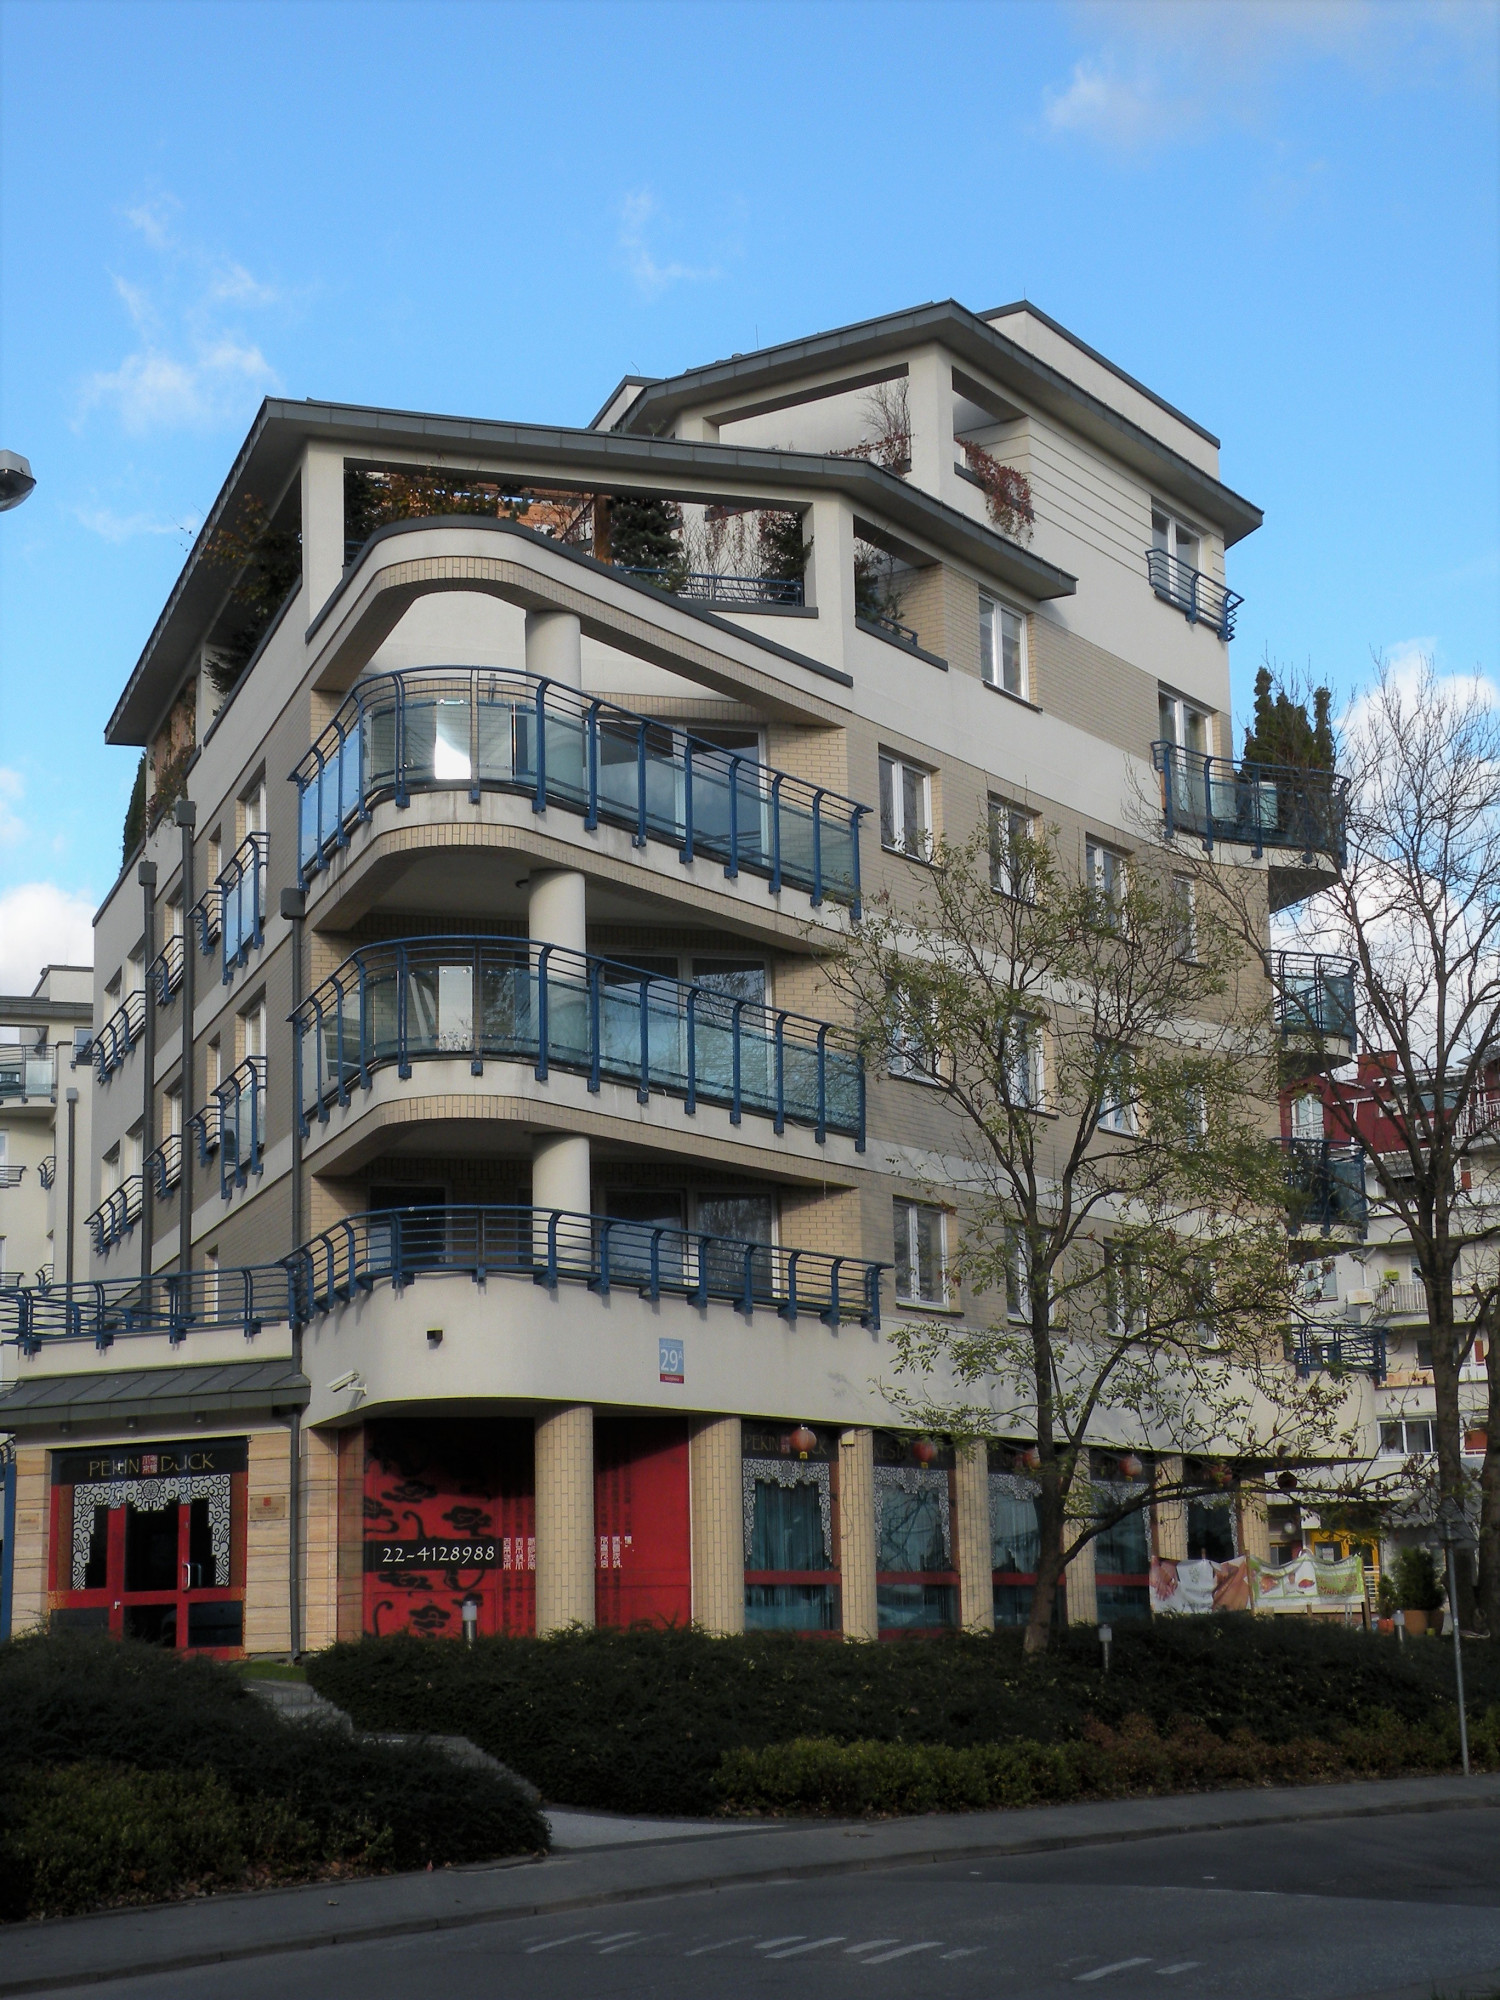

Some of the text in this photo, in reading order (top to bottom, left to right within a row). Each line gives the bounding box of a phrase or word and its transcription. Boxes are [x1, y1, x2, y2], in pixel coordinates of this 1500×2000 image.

[89, 1458, 140, 1477] PEKIN
[160, 1453, 215, 1472] DUCK
[382, 1545, 495, 1564] 22-4128988
